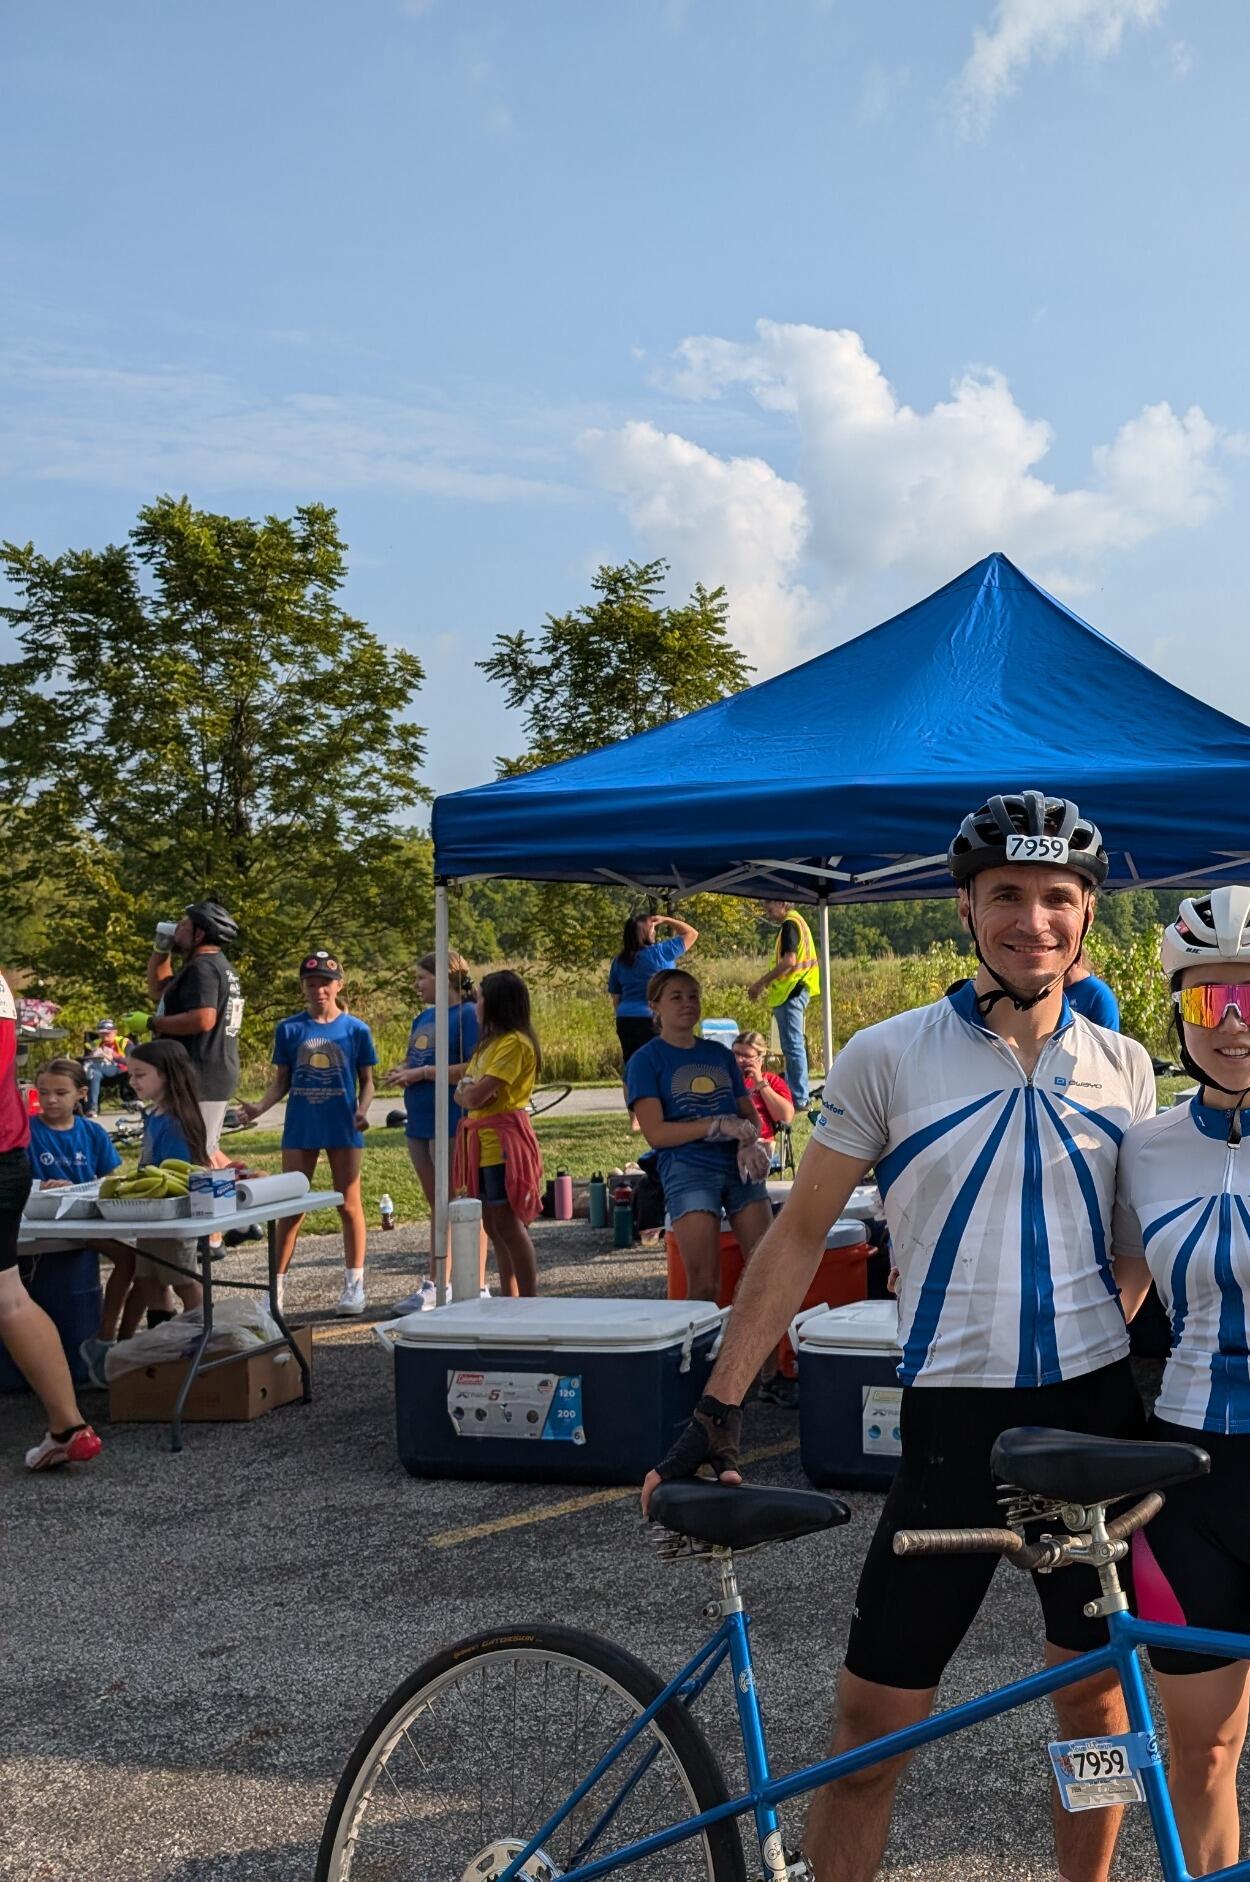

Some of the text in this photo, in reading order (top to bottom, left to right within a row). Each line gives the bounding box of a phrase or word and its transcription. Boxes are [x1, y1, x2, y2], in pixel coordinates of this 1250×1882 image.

[1011, 837, 1064, 859] 7959
[559, 1389, 576, 1398] 120
[557, 1409, 576, 1419] 200
[1073, 1749, 1124, 1779] 7959
